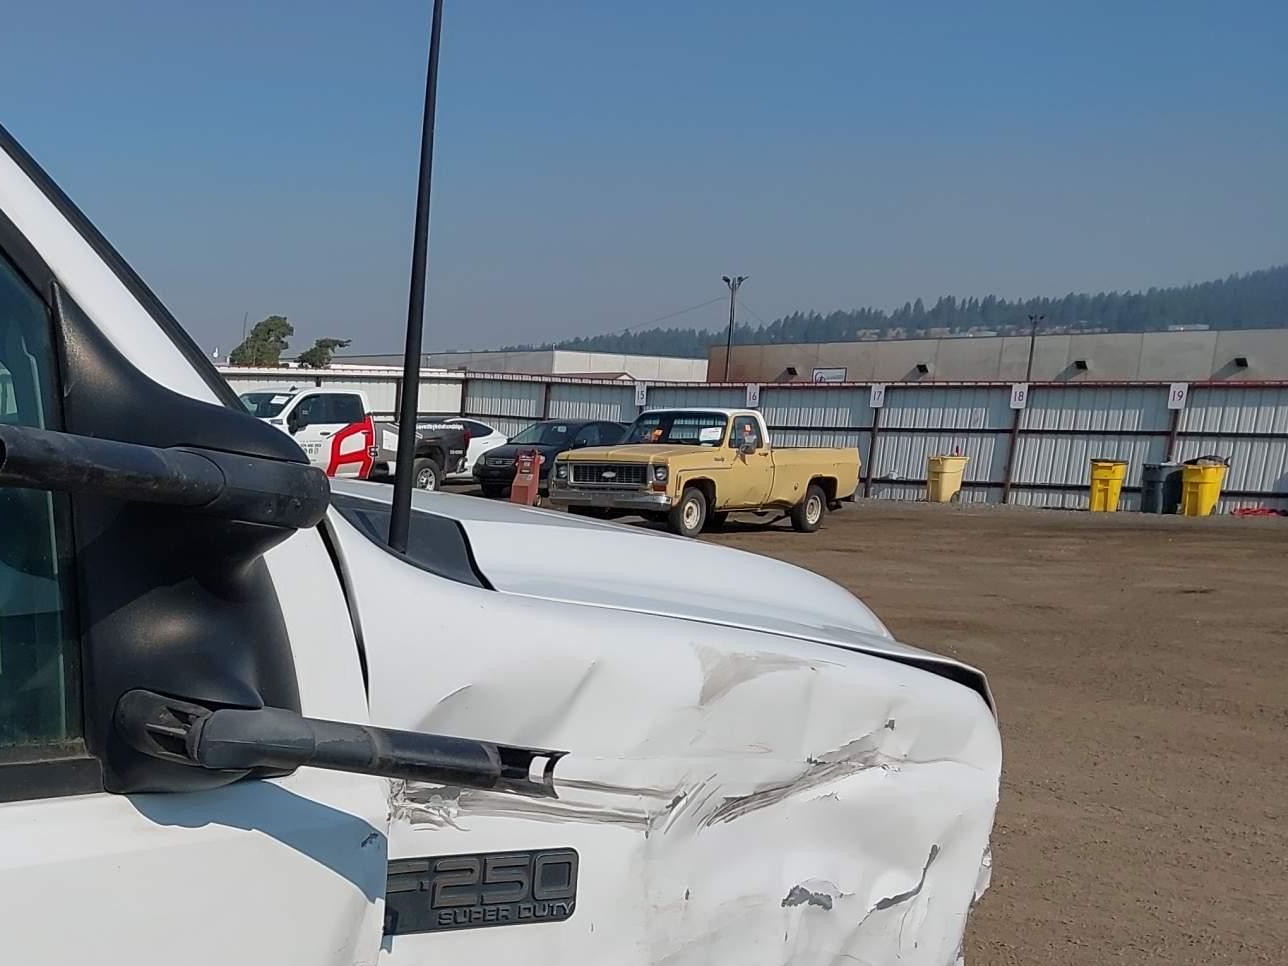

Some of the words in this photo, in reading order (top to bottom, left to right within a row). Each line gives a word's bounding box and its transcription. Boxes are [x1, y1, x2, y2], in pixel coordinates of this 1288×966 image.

[637, 390, 645, 401] 15
[749, 391, 757, 402] 16
[873, 390, 882, 401] 17
[1014, 391, 1024, 402] 18
[1172, 390, 1184, 402] 19
[438, 906, 510, 926] SUPER
[517, 901, 575, 919] DUTY
